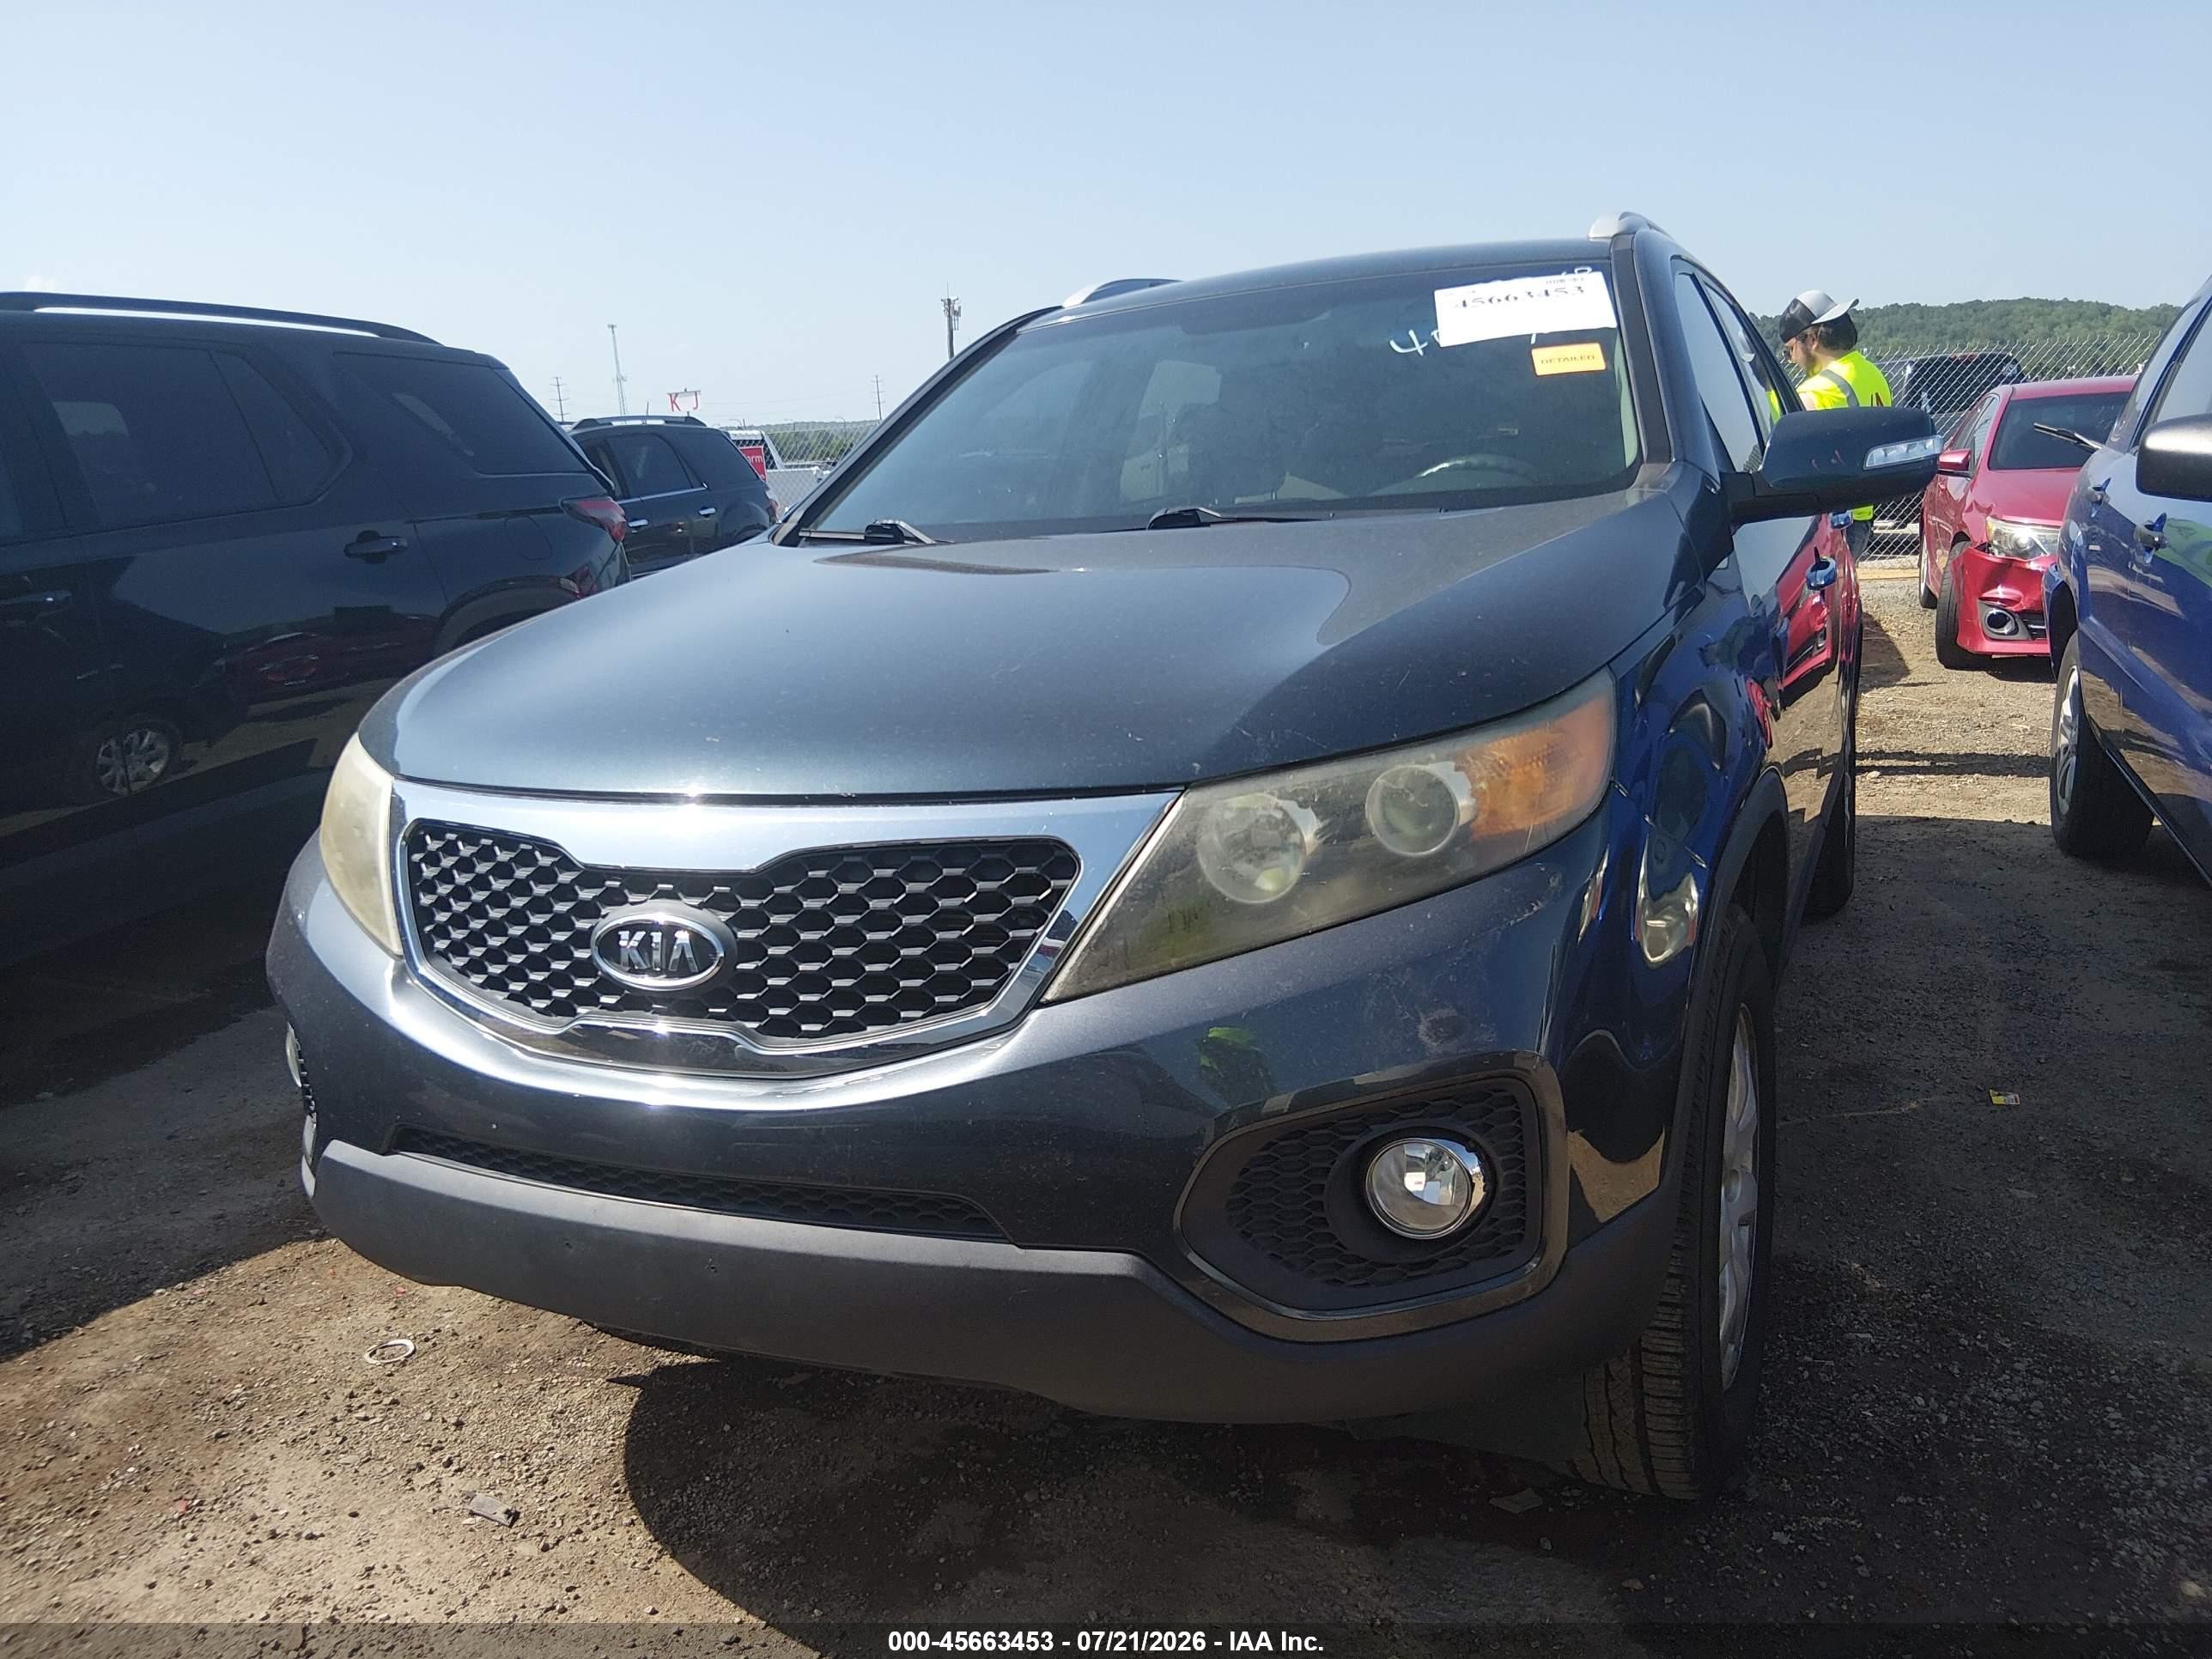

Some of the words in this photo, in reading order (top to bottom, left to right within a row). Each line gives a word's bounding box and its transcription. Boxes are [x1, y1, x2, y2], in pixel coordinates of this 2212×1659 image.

[1455, 284, 1585, 309] 45663453
[1540, 354, 1595, 365] DETAILED
[618, 930, 699, 973] KIA
